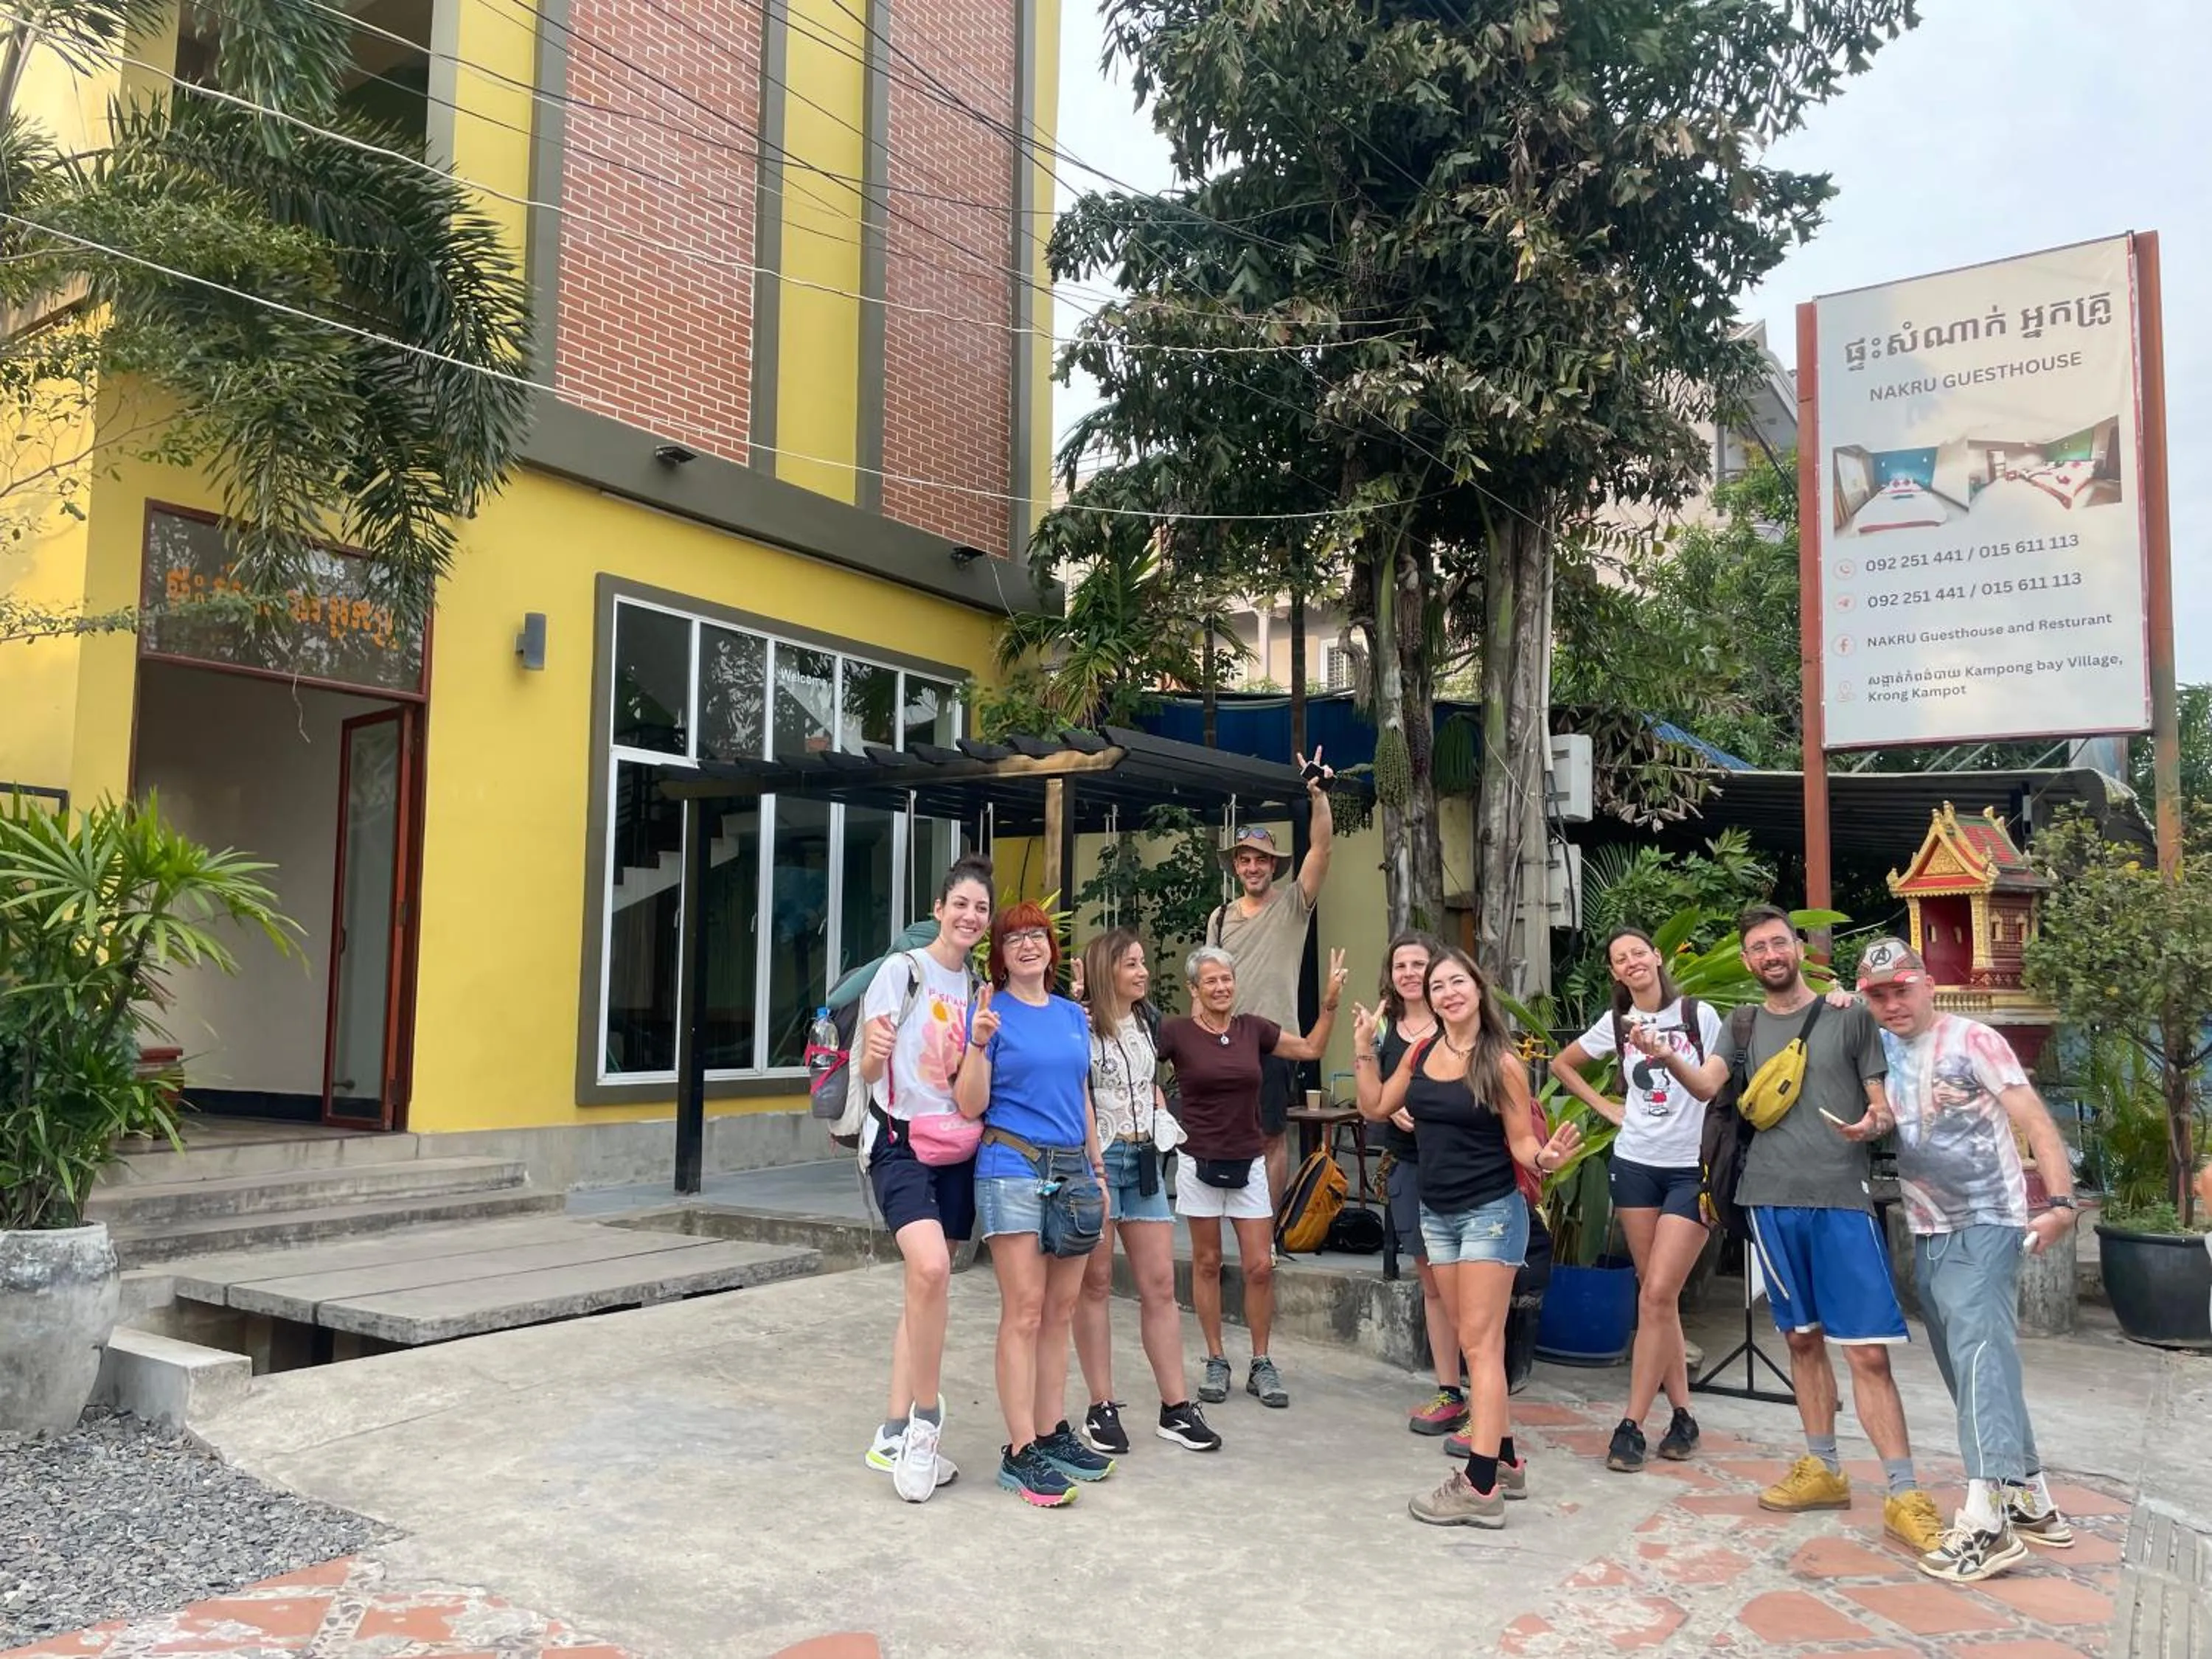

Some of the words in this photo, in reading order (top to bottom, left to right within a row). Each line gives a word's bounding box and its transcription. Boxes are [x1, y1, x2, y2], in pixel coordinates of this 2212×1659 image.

[1870, 377, 1937, 402] NAKRU
[1942, 351, 2082, 389] GUESTHOUSE
[1865, 557, 1896, 572] 092
[1901, 554, 1930, 568] 251
[1933, 549, 1964, 564] 441
[1967, 546, 1975, 562] /
[1979, 543, 2011, 559] 015
[2015, 538, 2045, 554] 611
[2049, 534, 2079, 550] 113
[1867, 594, 1899, 608] 092
[1902, 590, 1931, 605] 251
[1935, 586, 1966, 601] 441
[1969, 583, 1977, 599] /
[1981, 580, 2014, 596] 015
[2017, 577, 2048, 591] 611
[2052, 571, 2082, 588] 113
[1867, 633, 1916, 647] NAKRU
[1919, 626, 2004, 642] Guesthouse
[2007, 620, 2034, 634] and
[2038, 613, 2112, 630] Resturant
[1965, 662, 2034, 678] Kampong
[2036, 660, 2064, 672] bay
[2067, 655, 2123, 668] Village,
[1868, 690, 1909, 703] Krong
[1912, 685, 1966, 699] Kampot
